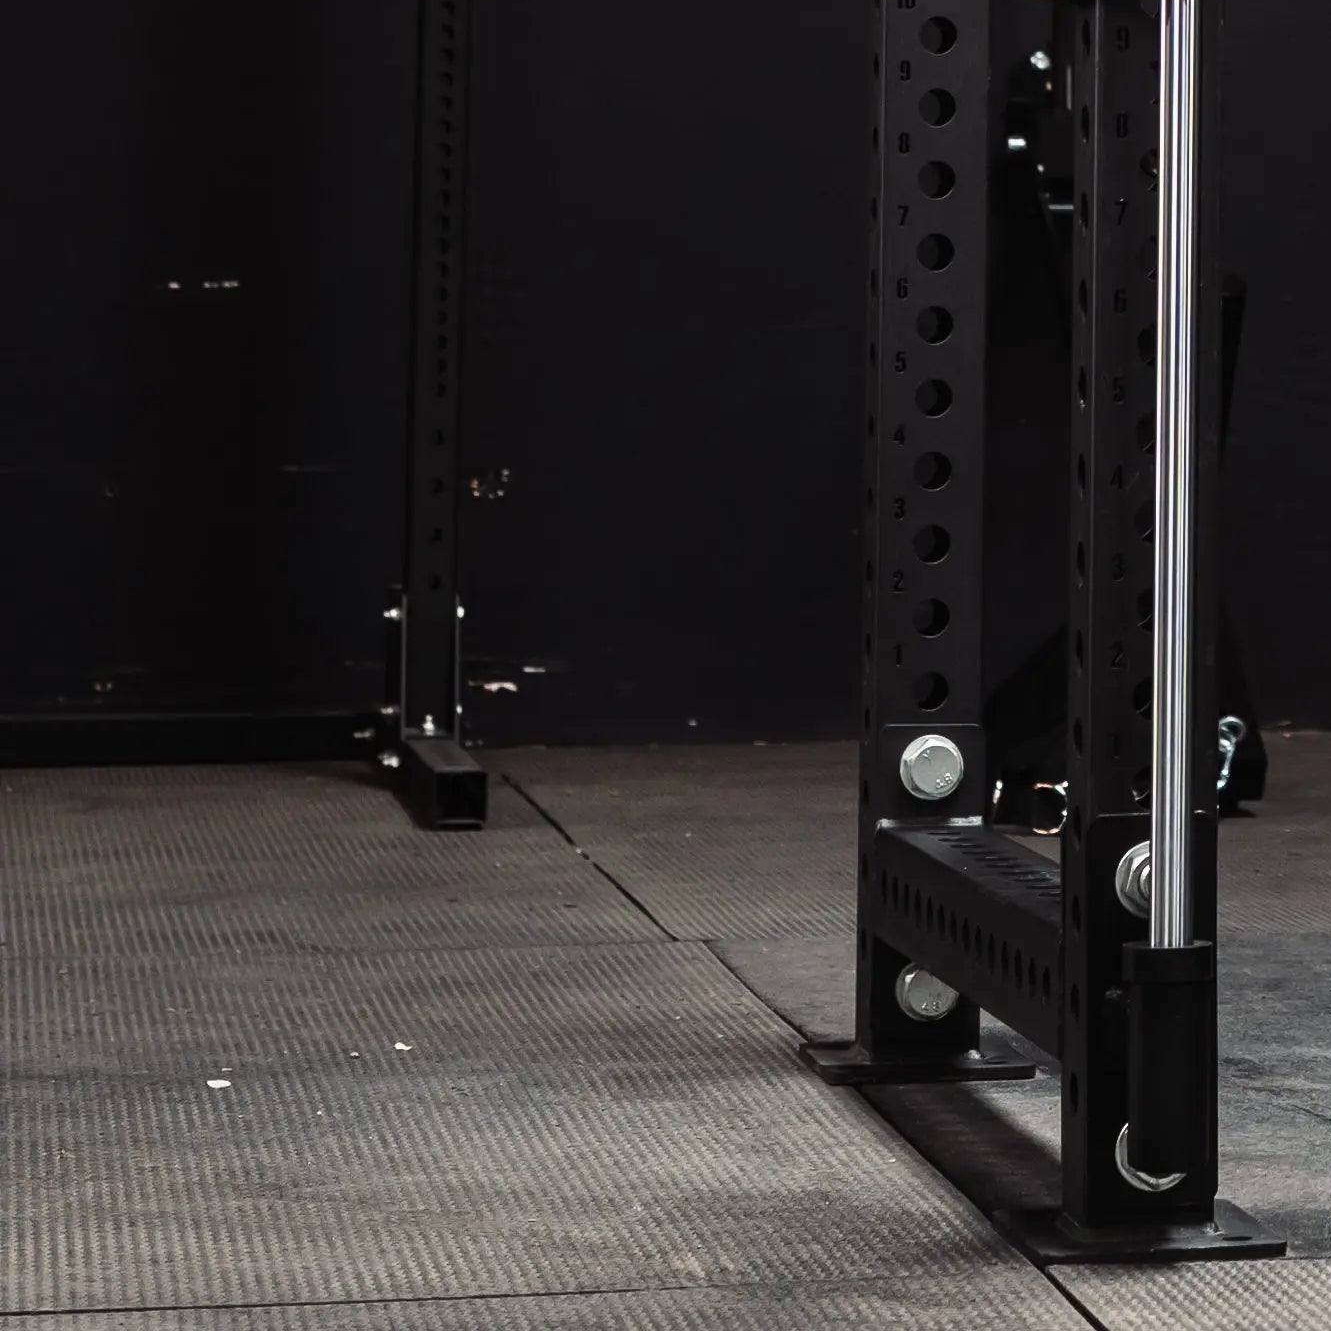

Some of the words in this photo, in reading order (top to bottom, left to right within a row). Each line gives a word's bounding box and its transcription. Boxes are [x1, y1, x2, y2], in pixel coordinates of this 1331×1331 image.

[900, 61, 911, 81] 9
[898, 133, 909, 153] 8
[898, 206, 908, 226] 7
[1115, 200, 1127, 225] 7
[897, 278, 908, 298] 6
[895, 352, 907, 372] 5
[1113, 377, 1125, 402] 5
[893, 425, 905, 444] 4
[894, 499, 905, 519] 3
[893, 571, 904, 592] 2
